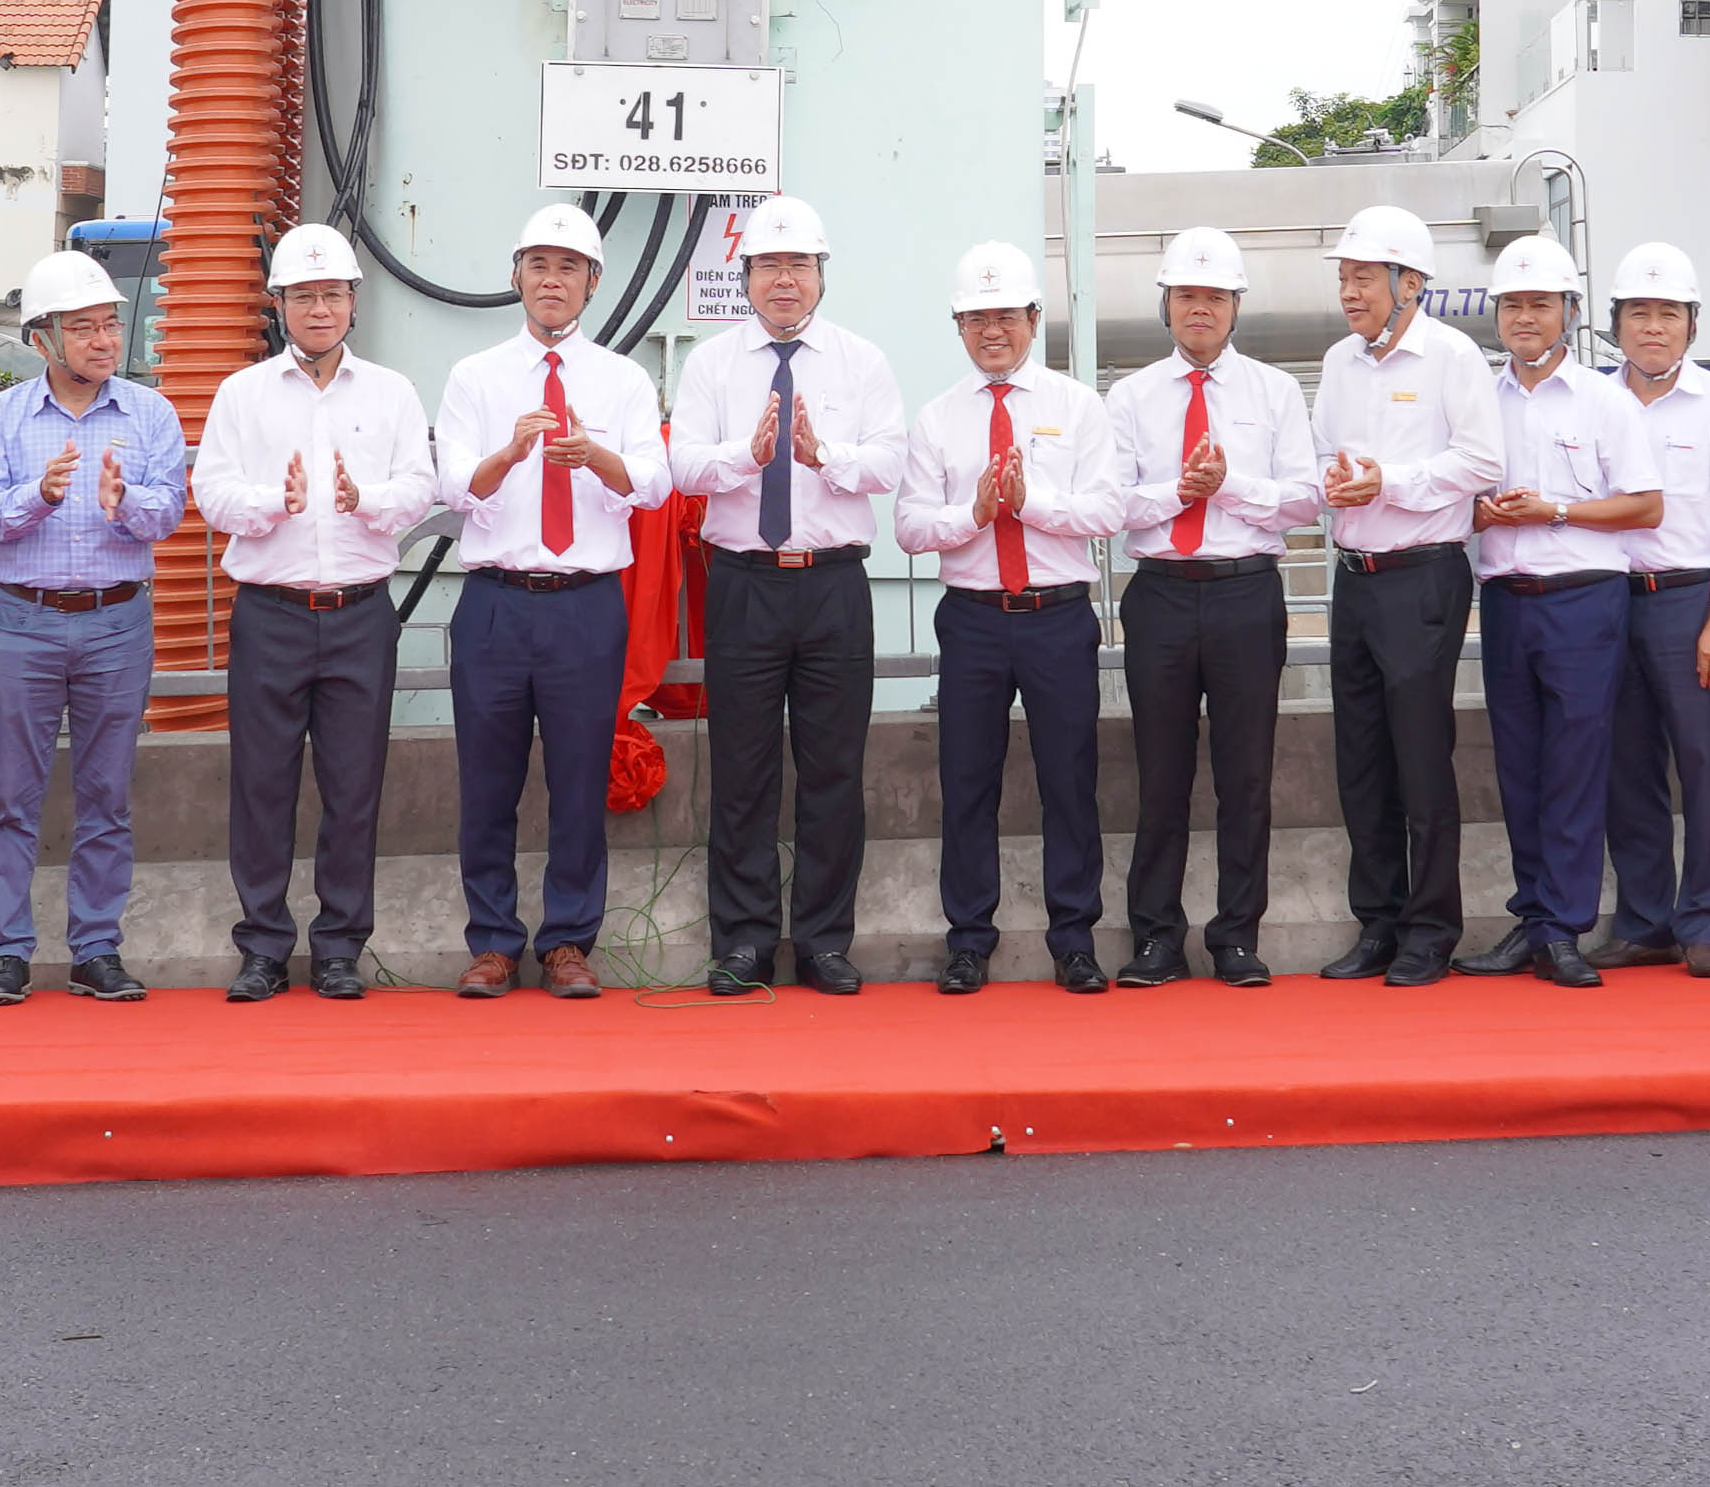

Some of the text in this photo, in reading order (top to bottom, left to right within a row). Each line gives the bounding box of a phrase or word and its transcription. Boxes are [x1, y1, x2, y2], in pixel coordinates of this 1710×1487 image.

[625, 91, 685, 141] 41
[553, 153, 767, 174] SĐT: 028.6258666
[696, 270, 742, 283] ĐIỆN CA
[700, 288, 731, 298] NGUY
[698, 302, 726, 315] CHẾT
